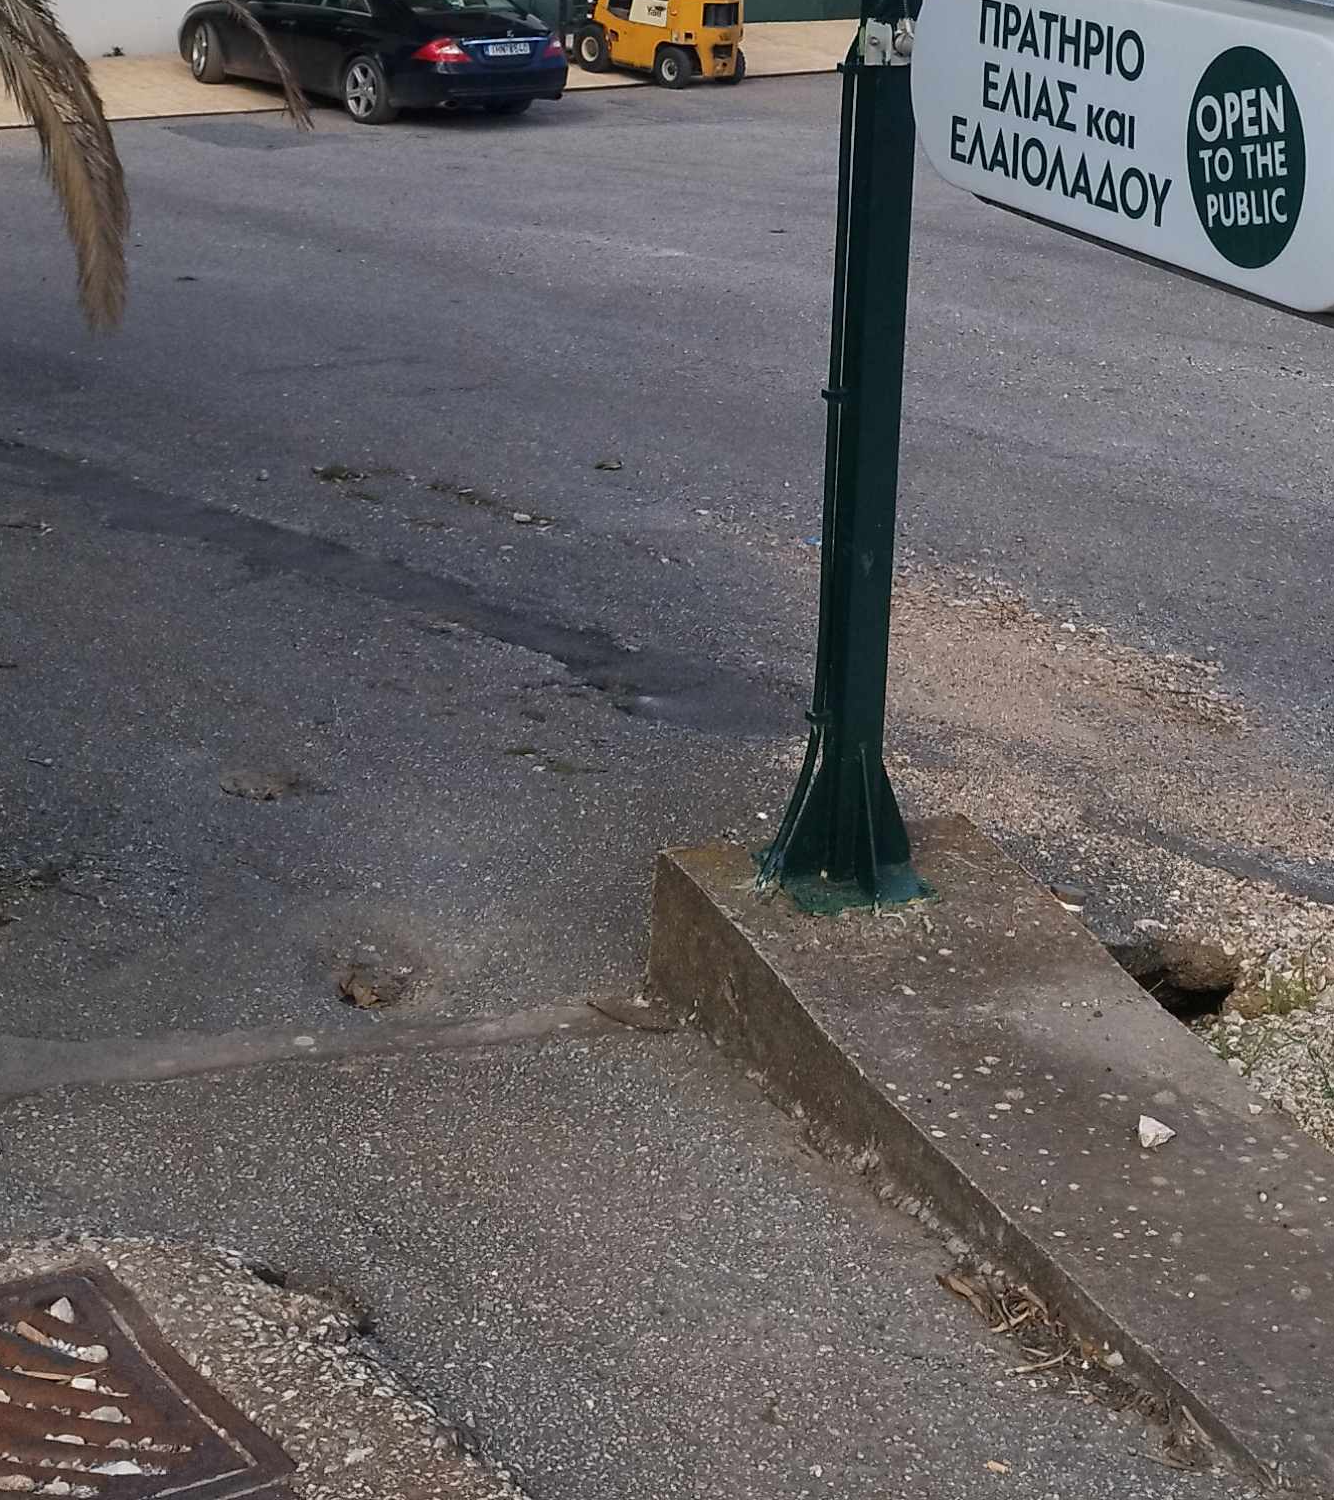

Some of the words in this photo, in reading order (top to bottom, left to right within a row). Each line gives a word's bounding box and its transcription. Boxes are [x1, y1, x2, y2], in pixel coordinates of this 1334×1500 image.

[982, 62, 1077, 133] ΕΛΙΑΣ
[1085, 104, 1136, 150] και
[1196, 84, 1285, 142] OPEN
[950, 115, 1172, 228] ΕΛΑΙΟΛΑΔΟΥ
[1200, 149, 1235, 182] TO
[1239, 141, 1288, 179] THE
[1206, 187, 1288, 229] PUBLIC
